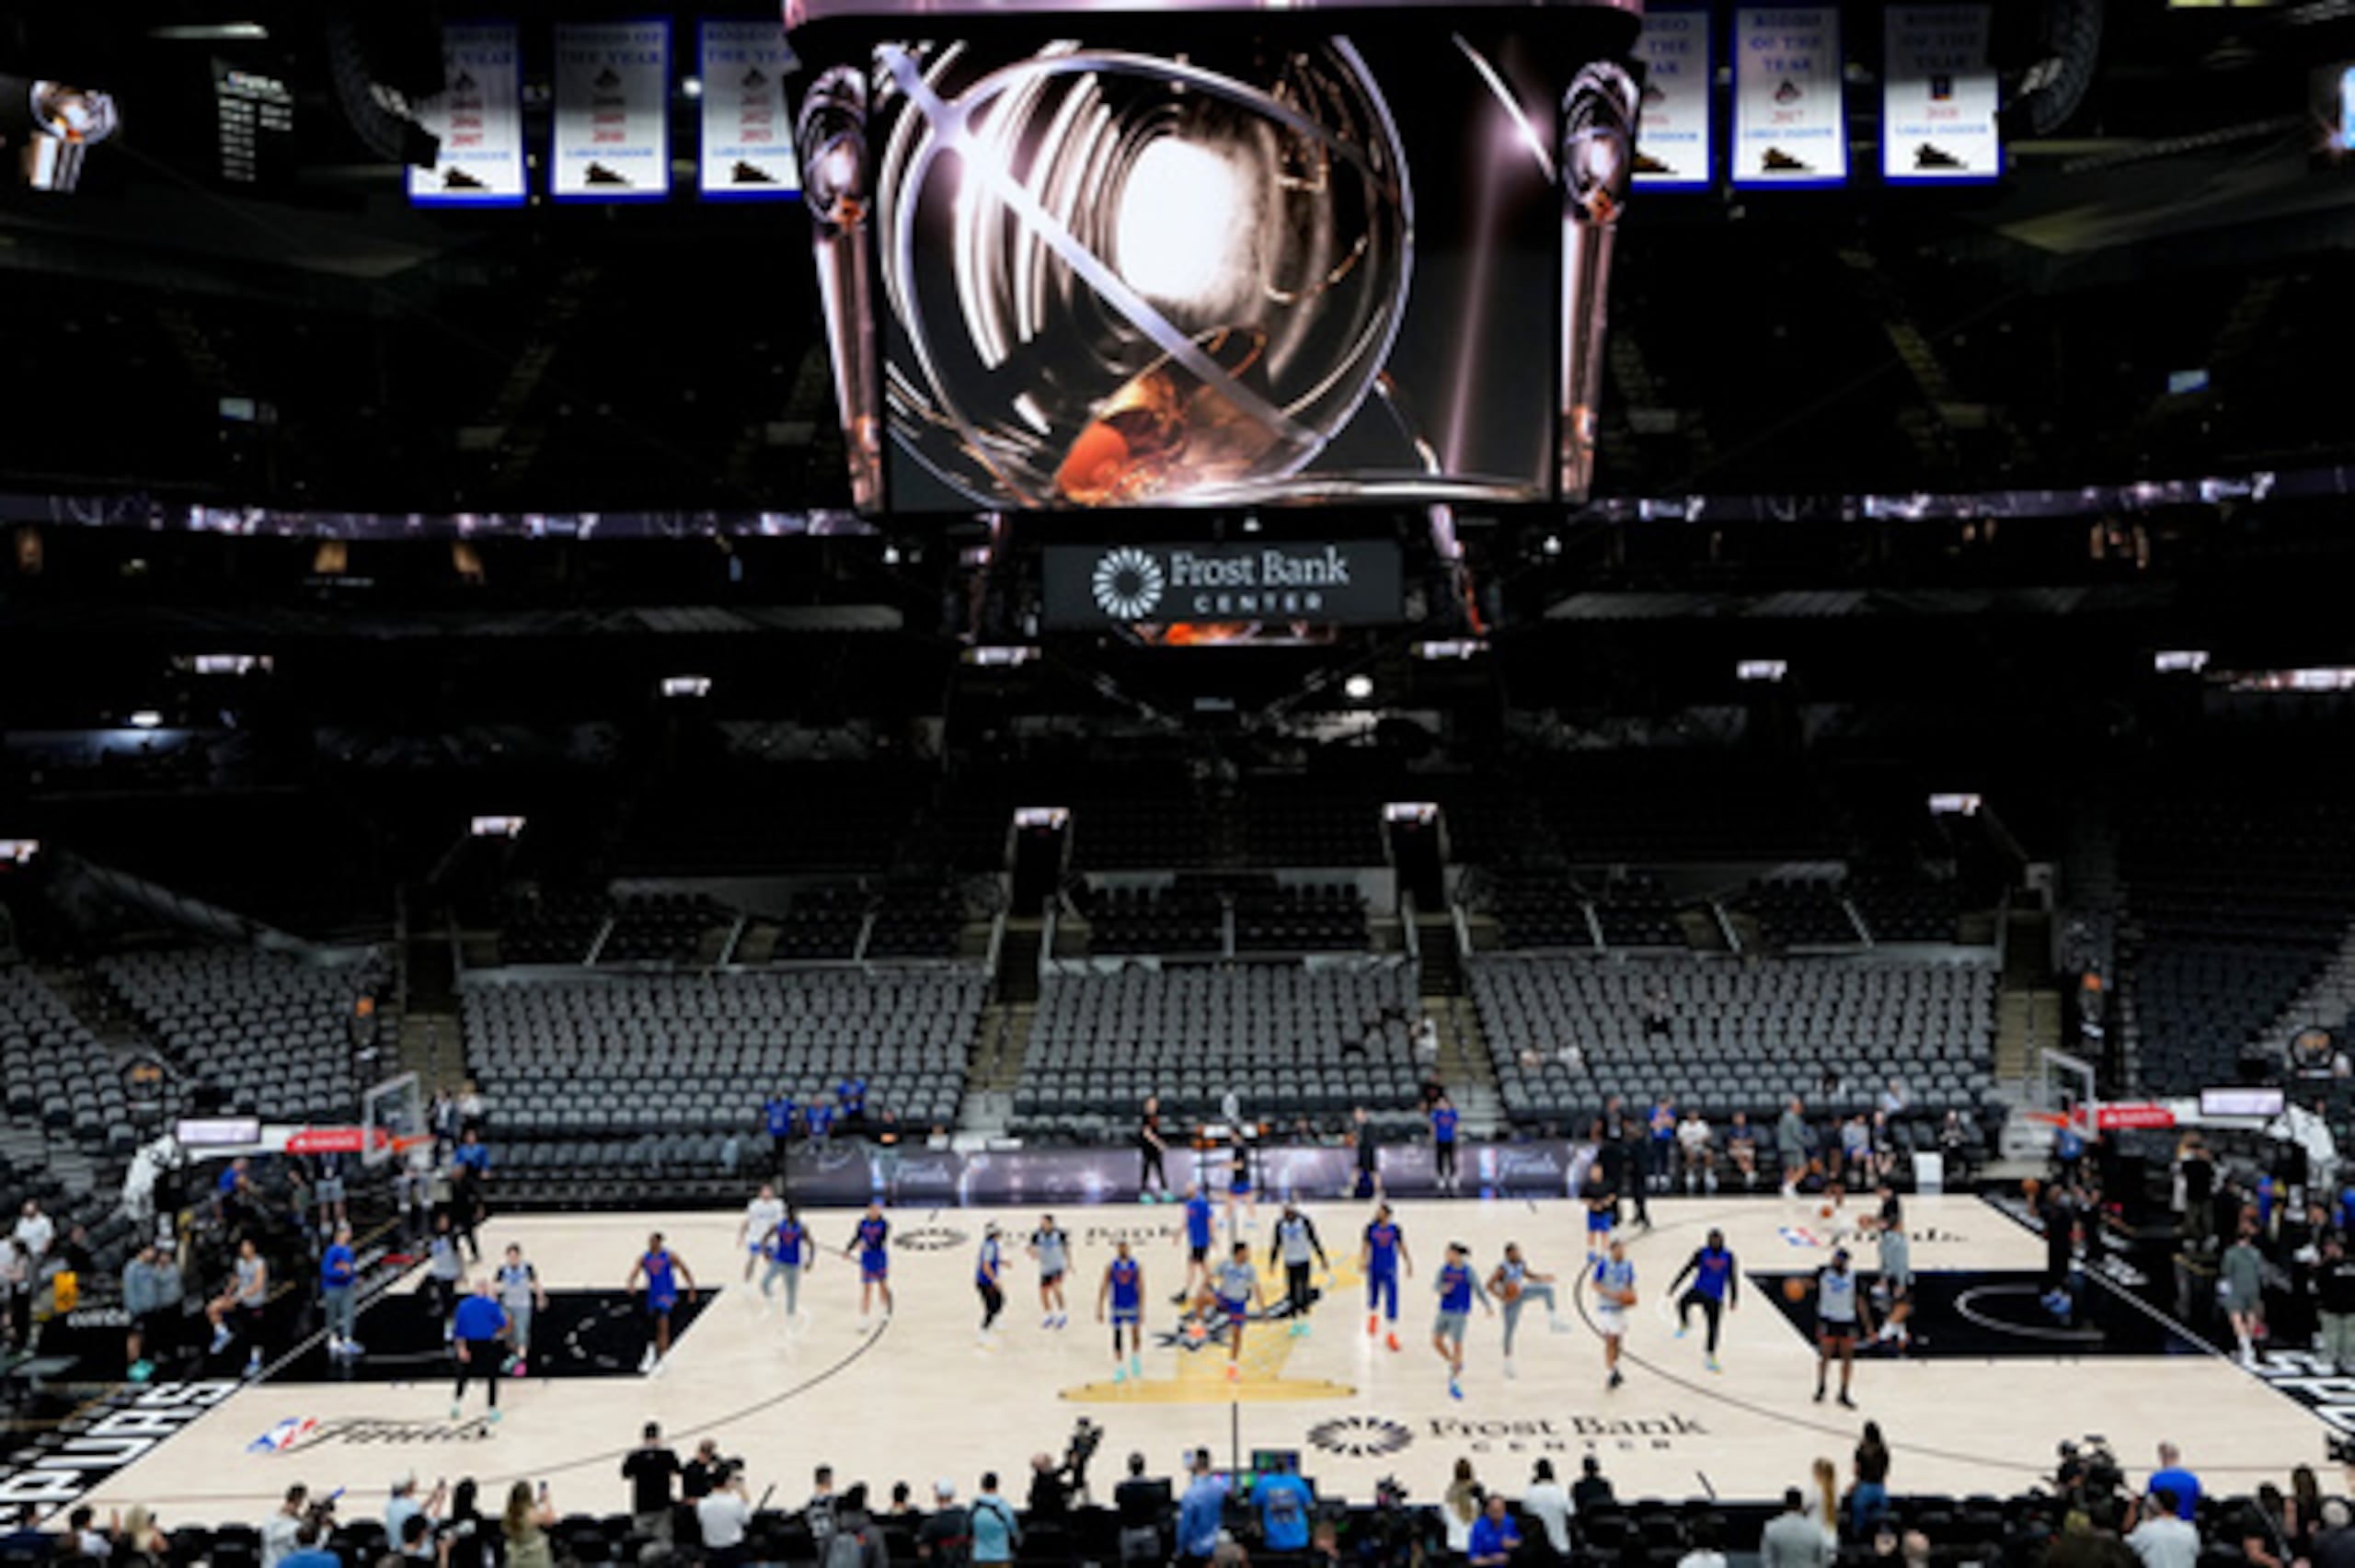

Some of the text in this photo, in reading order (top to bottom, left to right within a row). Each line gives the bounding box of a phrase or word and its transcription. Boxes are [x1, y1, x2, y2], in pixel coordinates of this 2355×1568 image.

[1170, 545, 1350, 587] Frost Bank
[1194, 592, 1323, 614] CENTER
[1429, 1413, 1709, 1437] Frost Bank
[1470, 1440, 1671, 1454] CENTER
